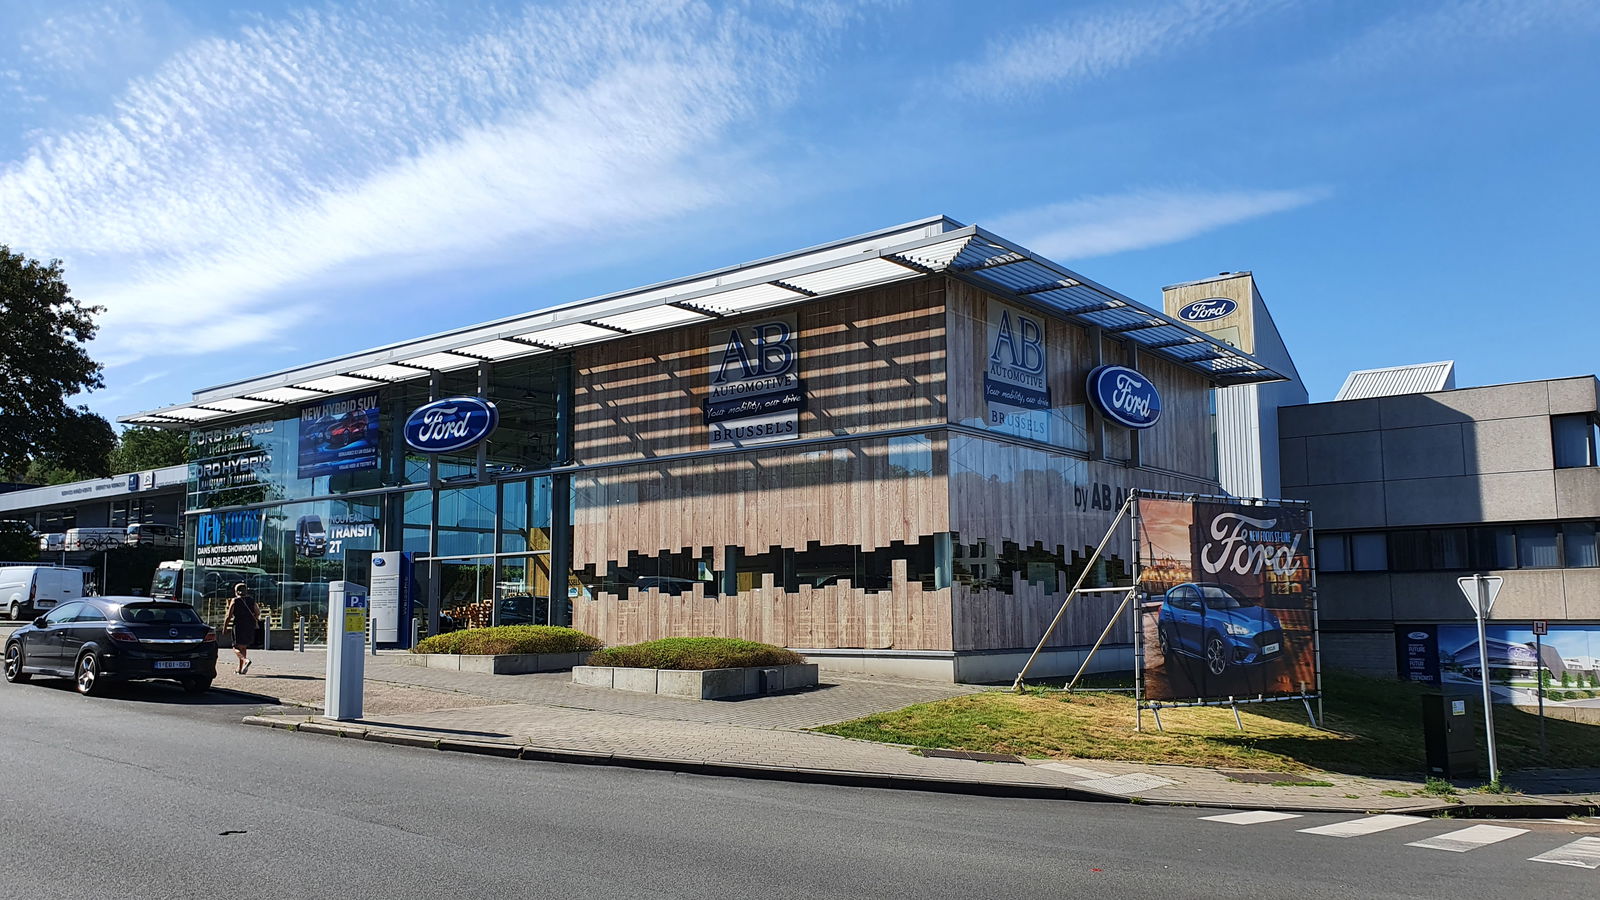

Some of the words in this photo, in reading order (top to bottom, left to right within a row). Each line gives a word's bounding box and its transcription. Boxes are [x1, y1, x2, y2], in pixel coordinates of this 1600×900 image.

[1188, 301, 1227, 320] Ford
[989, 307, 1045, 375] AB
[712, 321, 794, 386] AB
[712, 376, 792, 398] AUTOMOTIVE
[990, 363, 1043, 389] AUTOMOTIVE
[985, 384, 1001, 396] Your
[1112, 373, 1151, 418] Ford
[301, 406, 322, 422] NEW
[322, 399, 357, 417] HYBRID
[357, 395, 378, 411] SUV
[706, 407, 726, 419] Your
[727, 401, 763, 413] mobility,
[764, 399, 781, 408] our
[782, 393, 802, 405] drive
[418, 406, 472, 442] Ford
[713, 420, 794, 442] BRUSSELS
[991, 410, 1046, 434] BRUSSELS
[1074, 481, 1088, 512] by
[1091, 482, 1112, 511] AB
[197, 513, 220, 546] NEW
[330, 523, 375, 539] TRANSIT
[1249, 530, 1260, 542] NEW
[197, 545, 211, 555] DANS
[211, 545, 228, 554] NOTRE
[228, 543, 258, 553] SHOWROOM
[328, 540, 343, 554] 2T
[1201, 512, 1303, 577] Ford
[221, 554, 258, 565] SHOWROOM
[350, 596, 360, 607] P
[1535, 622, 1545, 633] H
